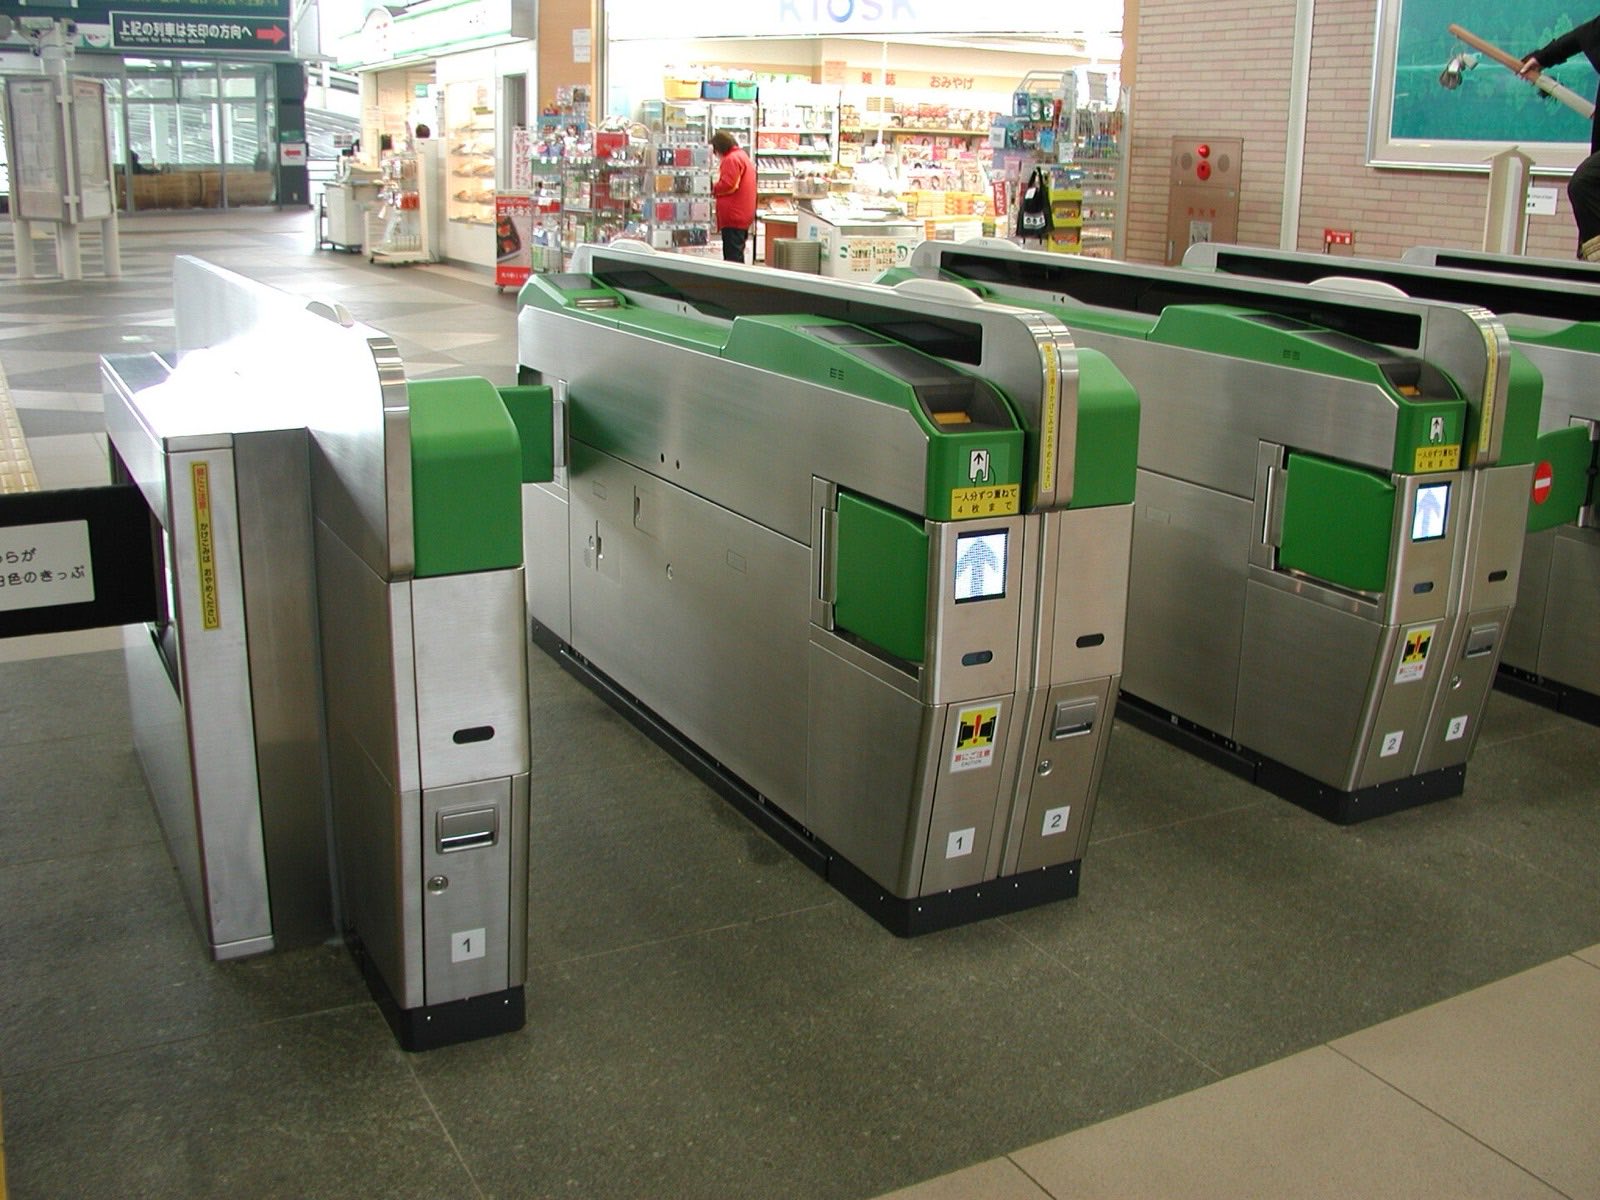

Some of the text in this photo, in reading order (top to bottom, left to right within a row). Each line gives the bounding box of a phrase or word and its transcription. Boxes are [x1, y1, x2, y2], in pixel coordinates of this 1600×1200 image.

[779, 0, 917, 23] KIOSK
[119, 20, 253, 40] 上記の列車は矢印の方向へ
[930, 76, 974, 90] おみやげ
[954, 488, 1017, 502] 一人分ずつ重ねて
[957, 501, 1012, 513] 4枚まで
[0, 547, 37, 564] らが
[204, 569, 217, 625] おやめください
[1452, 722, 1461, 735] 3
[1387, 738, 1397, 751] 2
[1050, 814, 1062, 829] 2
[955, 836, 963, 850] 1
[462, 938, 471, 953] 1
